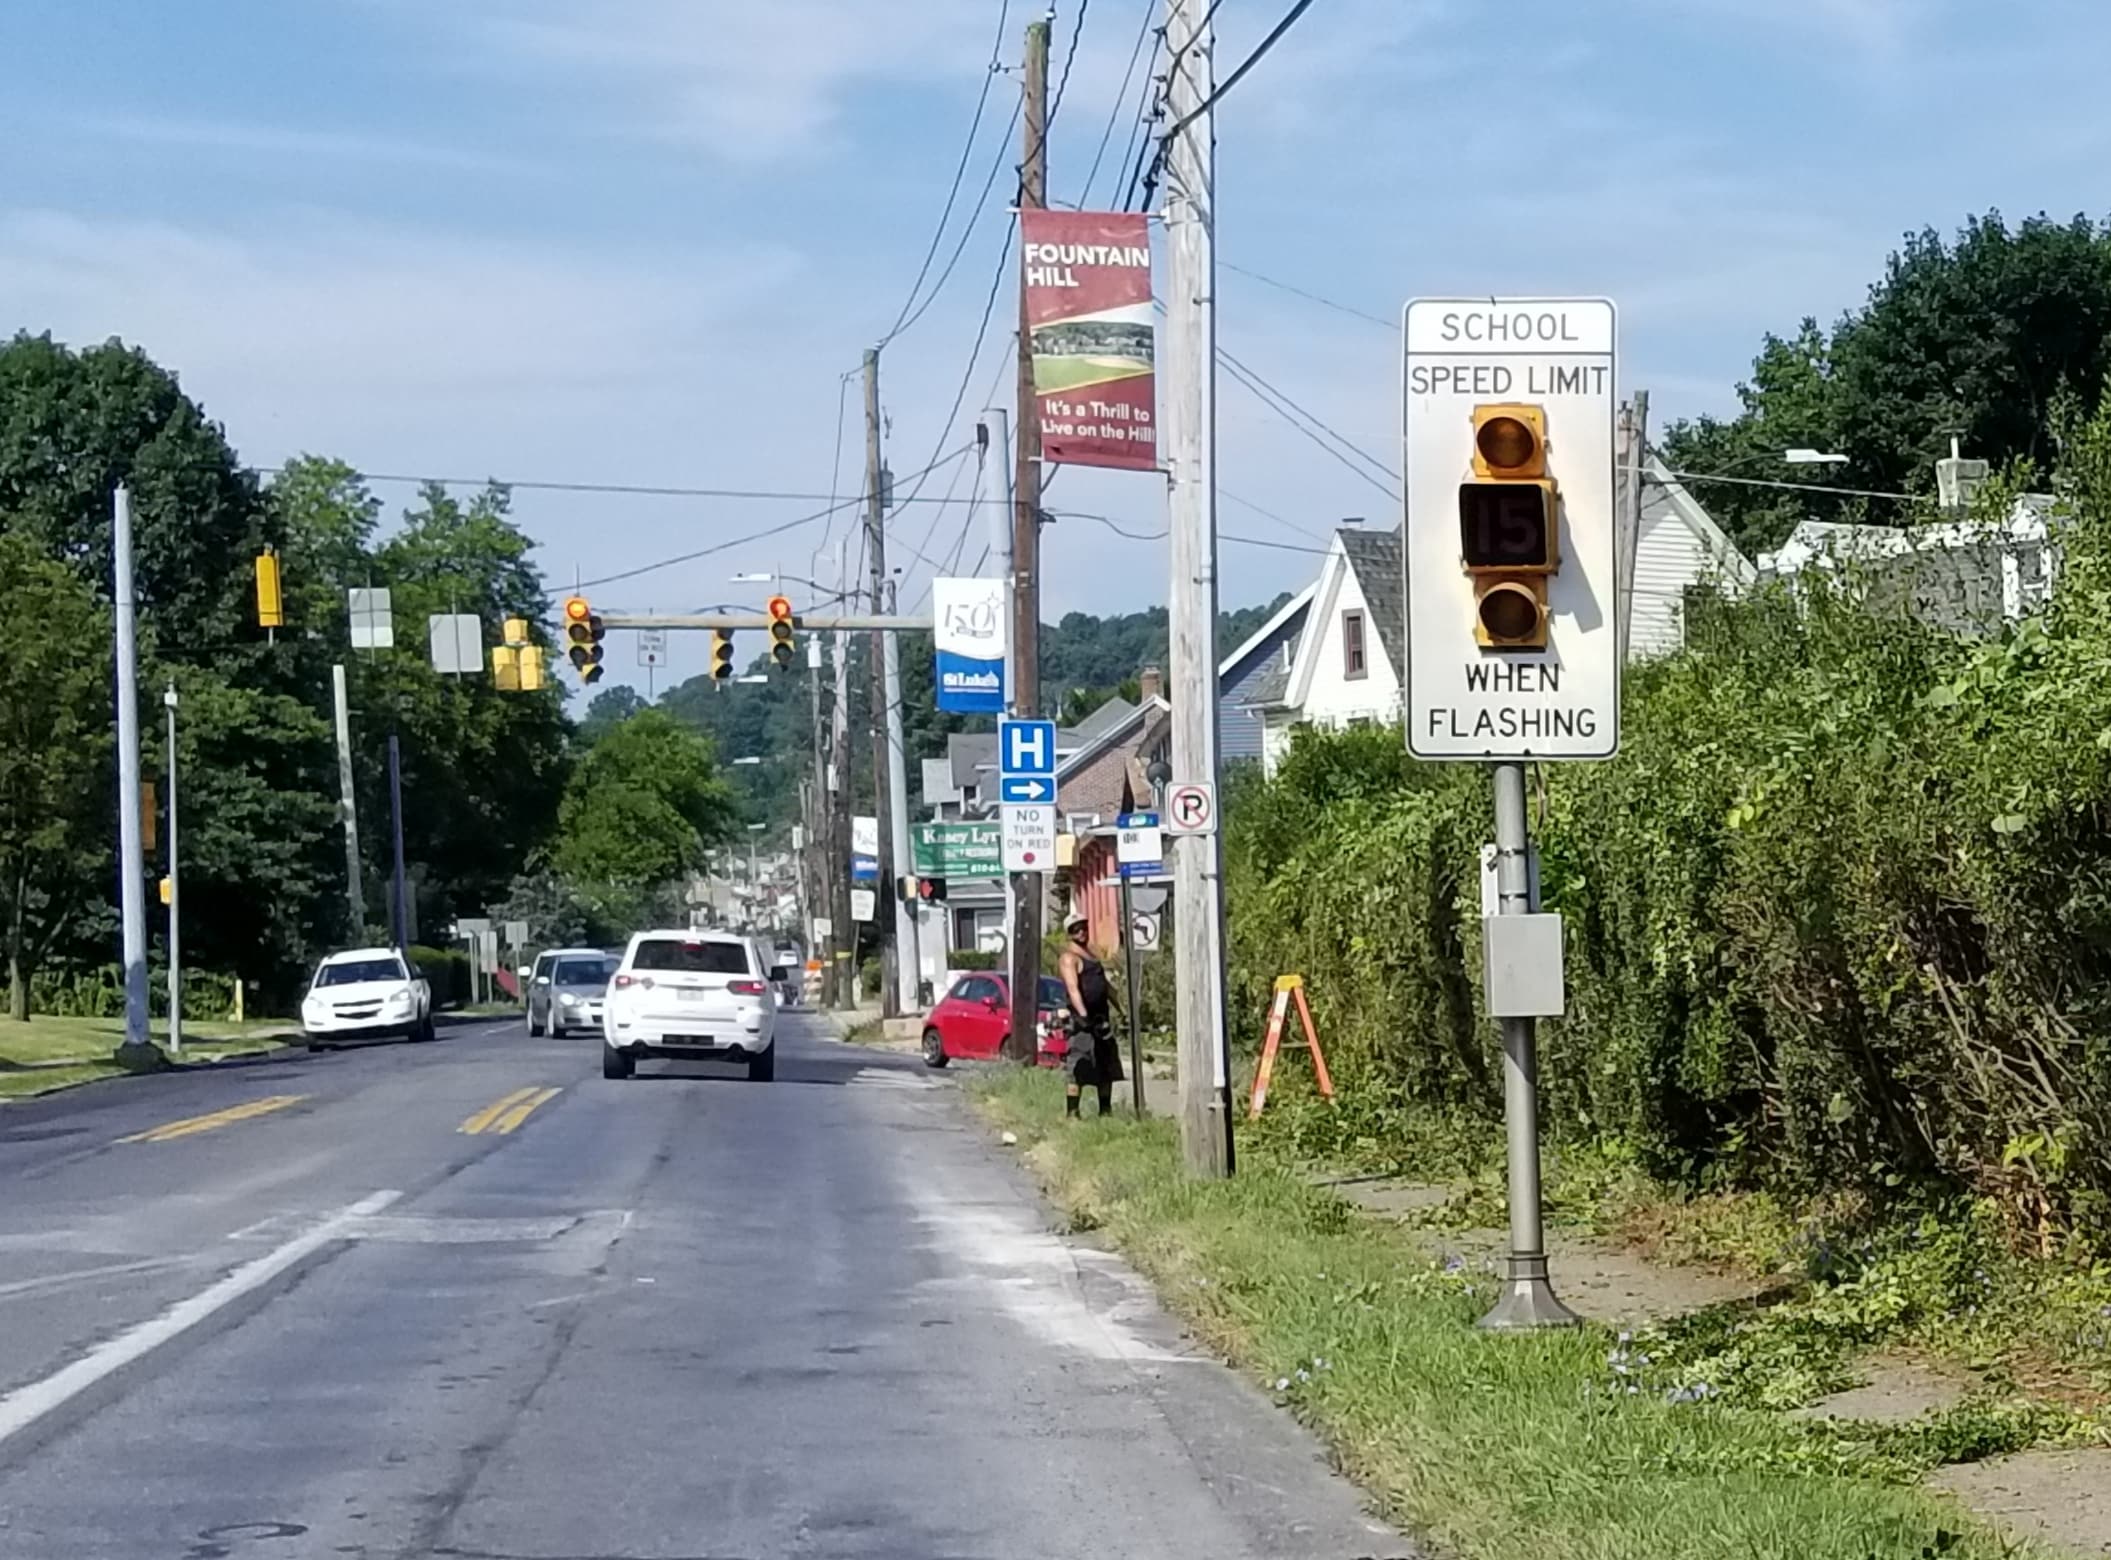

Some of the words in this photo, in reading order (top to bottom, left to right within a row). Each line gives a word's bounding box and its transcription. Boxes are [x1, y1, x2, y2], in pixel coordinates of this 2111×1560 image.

[1025, 244, 1149, 267] FOUNTAIN
[1028, 267, 1078, 287] HILL
[1441, 313, 1579, 341] SCHOOL
[1411, 366, 1512, 394] SPEED
[1529, 366, 1608, 395] LIMIT
[1045, 399, 1071, 416] It's
[1075, 405, 1086, 417] a
[1090, 401, 1129, 420] Thrill
[1134, 408, 1150, 422] to
[1041, 419, 1073, 435] Live
[1077, 425, 1097, 437] on
[1100, 424, 1125, 439] the
[1479, 499, 1537, 553] 15
[1465, 663, 1559, 692] WHEN
[1430, 708, 1596, 737] FLASHING
[1011, 728, 1044, 769] H
[1016, 809, 1040, 822] NO
[1013, 825, 1045, 835] TURN
[1007, 839, 1022, 849] ON
[1028, 839, 1051, 849] RED
